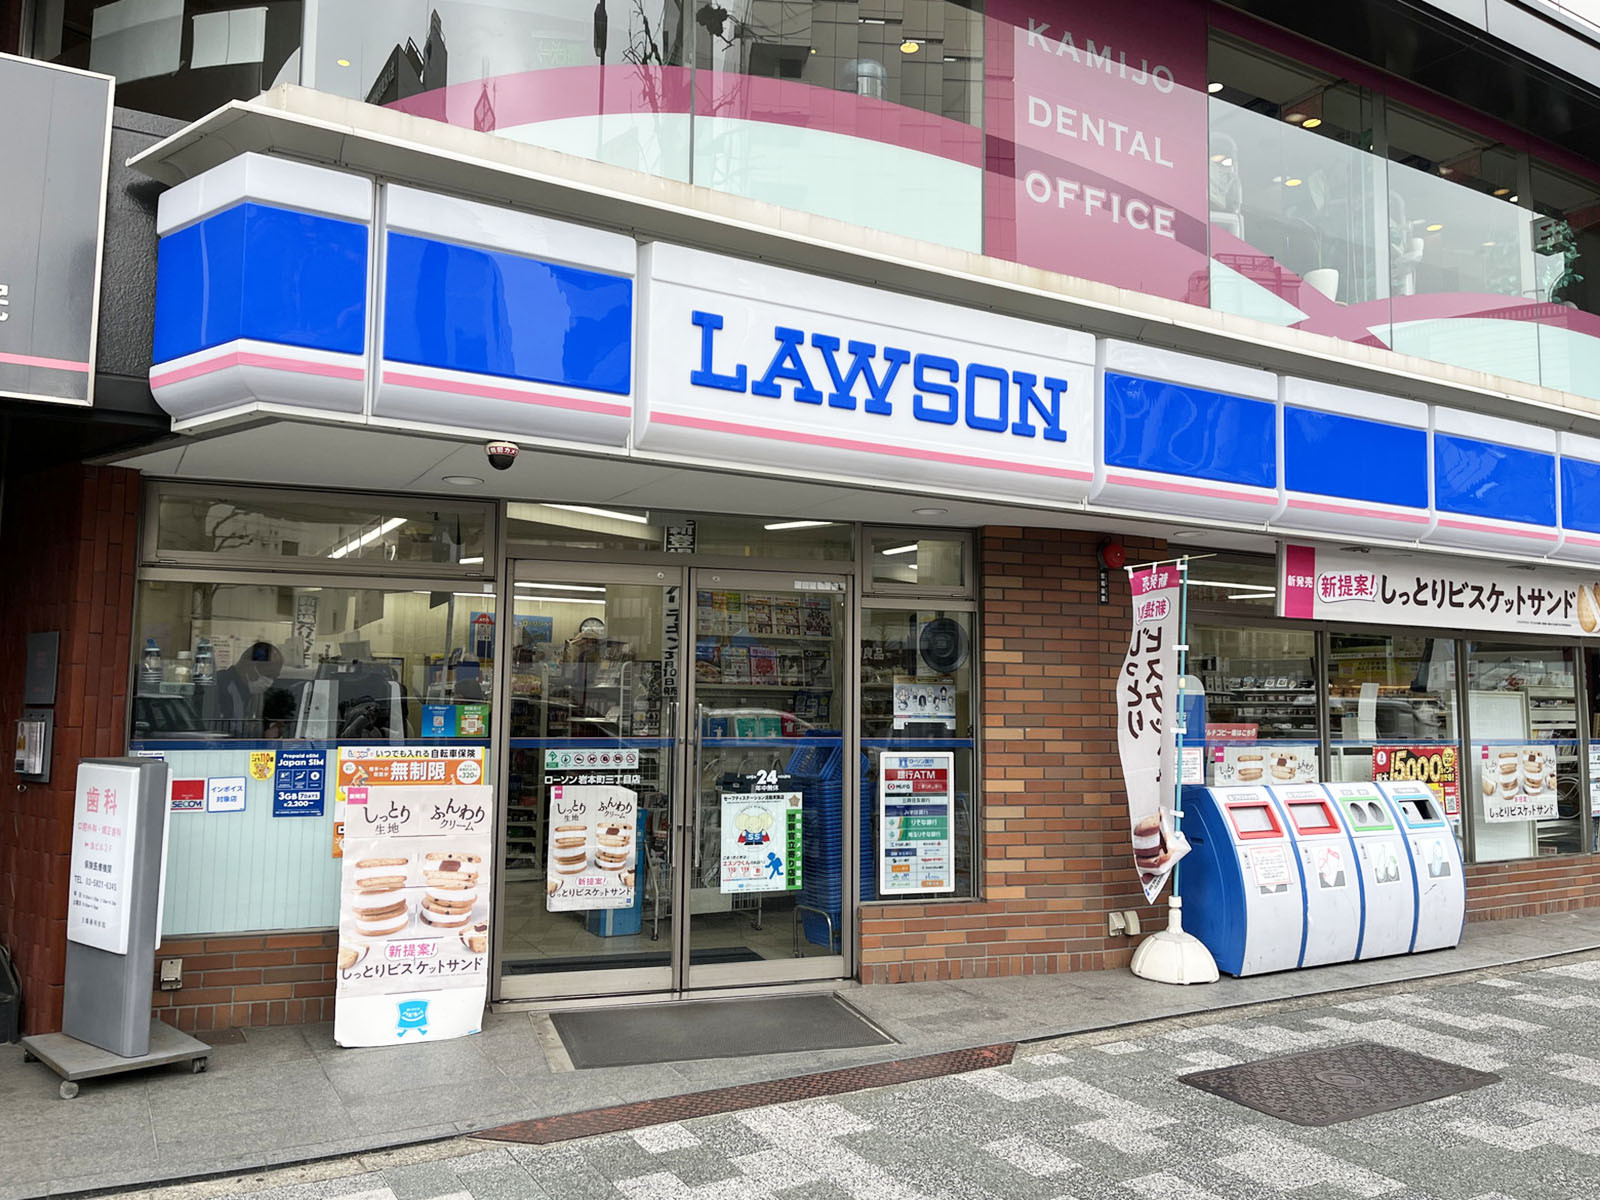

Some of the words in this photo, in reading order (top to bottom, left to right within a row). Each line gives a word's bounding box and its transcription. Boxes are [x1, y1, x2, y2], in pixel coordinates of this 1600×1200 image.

[1027, 17, 1175, 94] KAMIJO
[1028, 95, 1174, 169] DENTAL
[1025, 172, 1176, 239] OFFICE
[691, 310, 1068, 442] LAWSON
[1287, 575, 1314, 589] 新発売
[1320, 573, 1376, 598] 新提案!
[1381, 574, 1577, 619] しっとりビスケットサンド
[376, 748, 476, 759] いつでも入れる自転車保険
[278, 759, 307, 767] Japan
[308, 758, 325, 766] SIM
[390, 761, 447, 781] 無制限
[756, 769, 779, 785] 24
[897, 770, 936, 780] 銀行ATM
[544, 774, 641, 785] ローソン岩本町三丁目店
[211, 785, 244, 793] インボイス
[278, 791, 298, 800] 3GB
[86, 786, 118, 816] 歯科
[171, 800, 203, 808] SECOM
[216, 795, 238, 803] 対象店
[598, 797, 633, 814] ふんわり
[363, 801, 411, 824] しっとり
[430, 798, 486, 824] ふんわり
[556, 799, 587, 815] しっとり
[1489, 804, 1555, 818] しっとりビスケットサンド
[604, 811, 626, 820] クリーム
[375, 823, 400, 835] 生地
[440, 819, 475, 832] クリーム
[747, 833, 761, 841] SS
[550, 886, 633, 898] しっとりビスケットサンド
[388, 943, 437, 958] 新提案!
[341, 957, 484, 980] しっとりビスケットサンド
